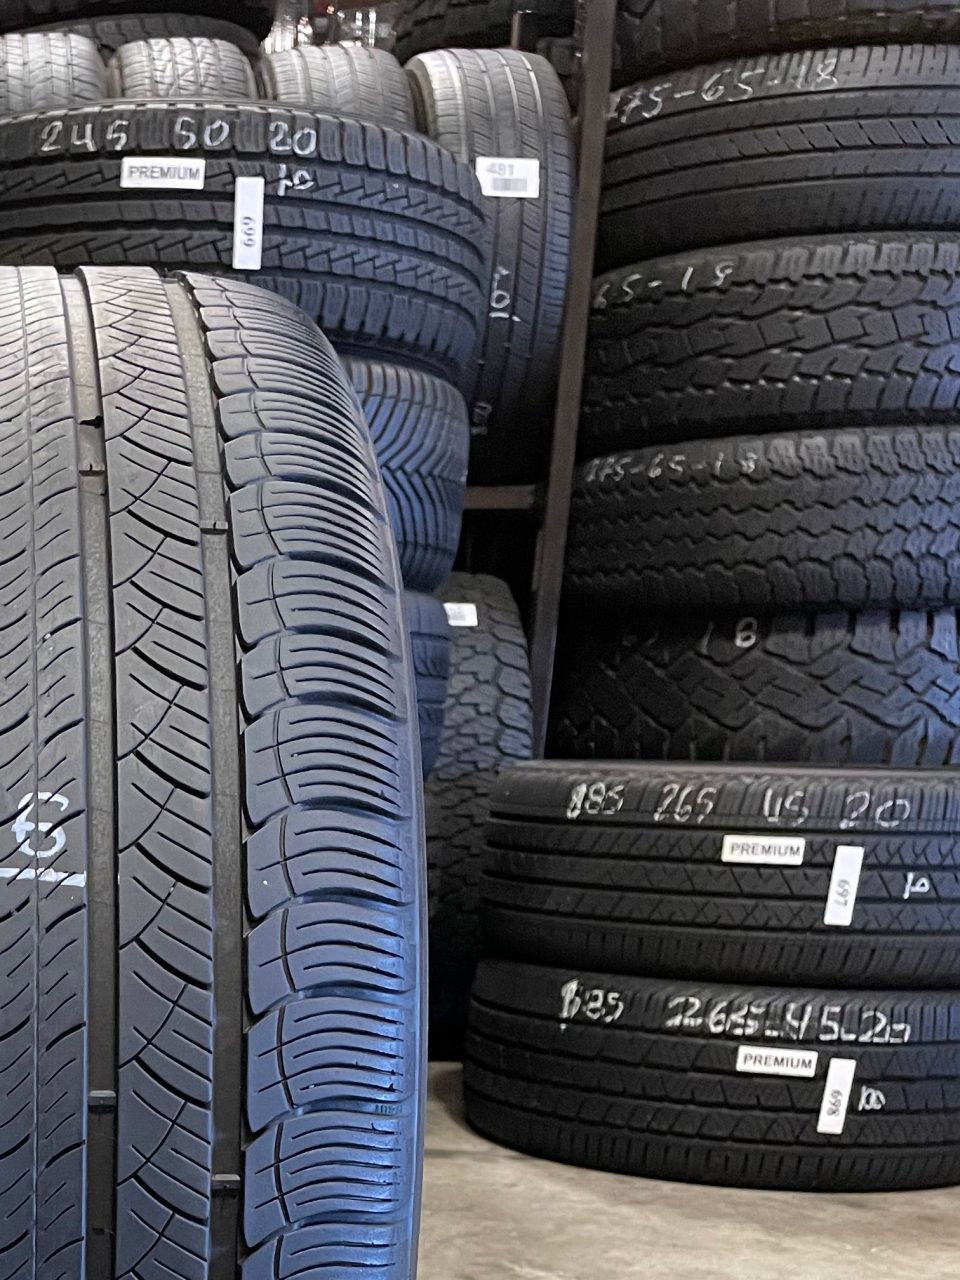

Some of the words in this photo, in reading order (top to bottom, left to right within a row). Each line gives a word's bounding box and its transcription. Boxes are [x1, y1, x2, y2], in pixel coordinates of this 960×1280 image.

[41, 120, 128, 151] 245
[173, 116, 230, 149] 50
[269, 121, 316, 155] 20
[129, 165, 200, 180] PREMIUM
[241, 216, 257, 247] 699
[653, 783, 717, 824] 265
[763, 788, 809, 826] 45
[839, 791, 910, 829] 20
[730, 842, 800, 857] PREMIUM
[834, 879, 850, 907] 697
[743, 1053, 812, 1070] PREMIUM
